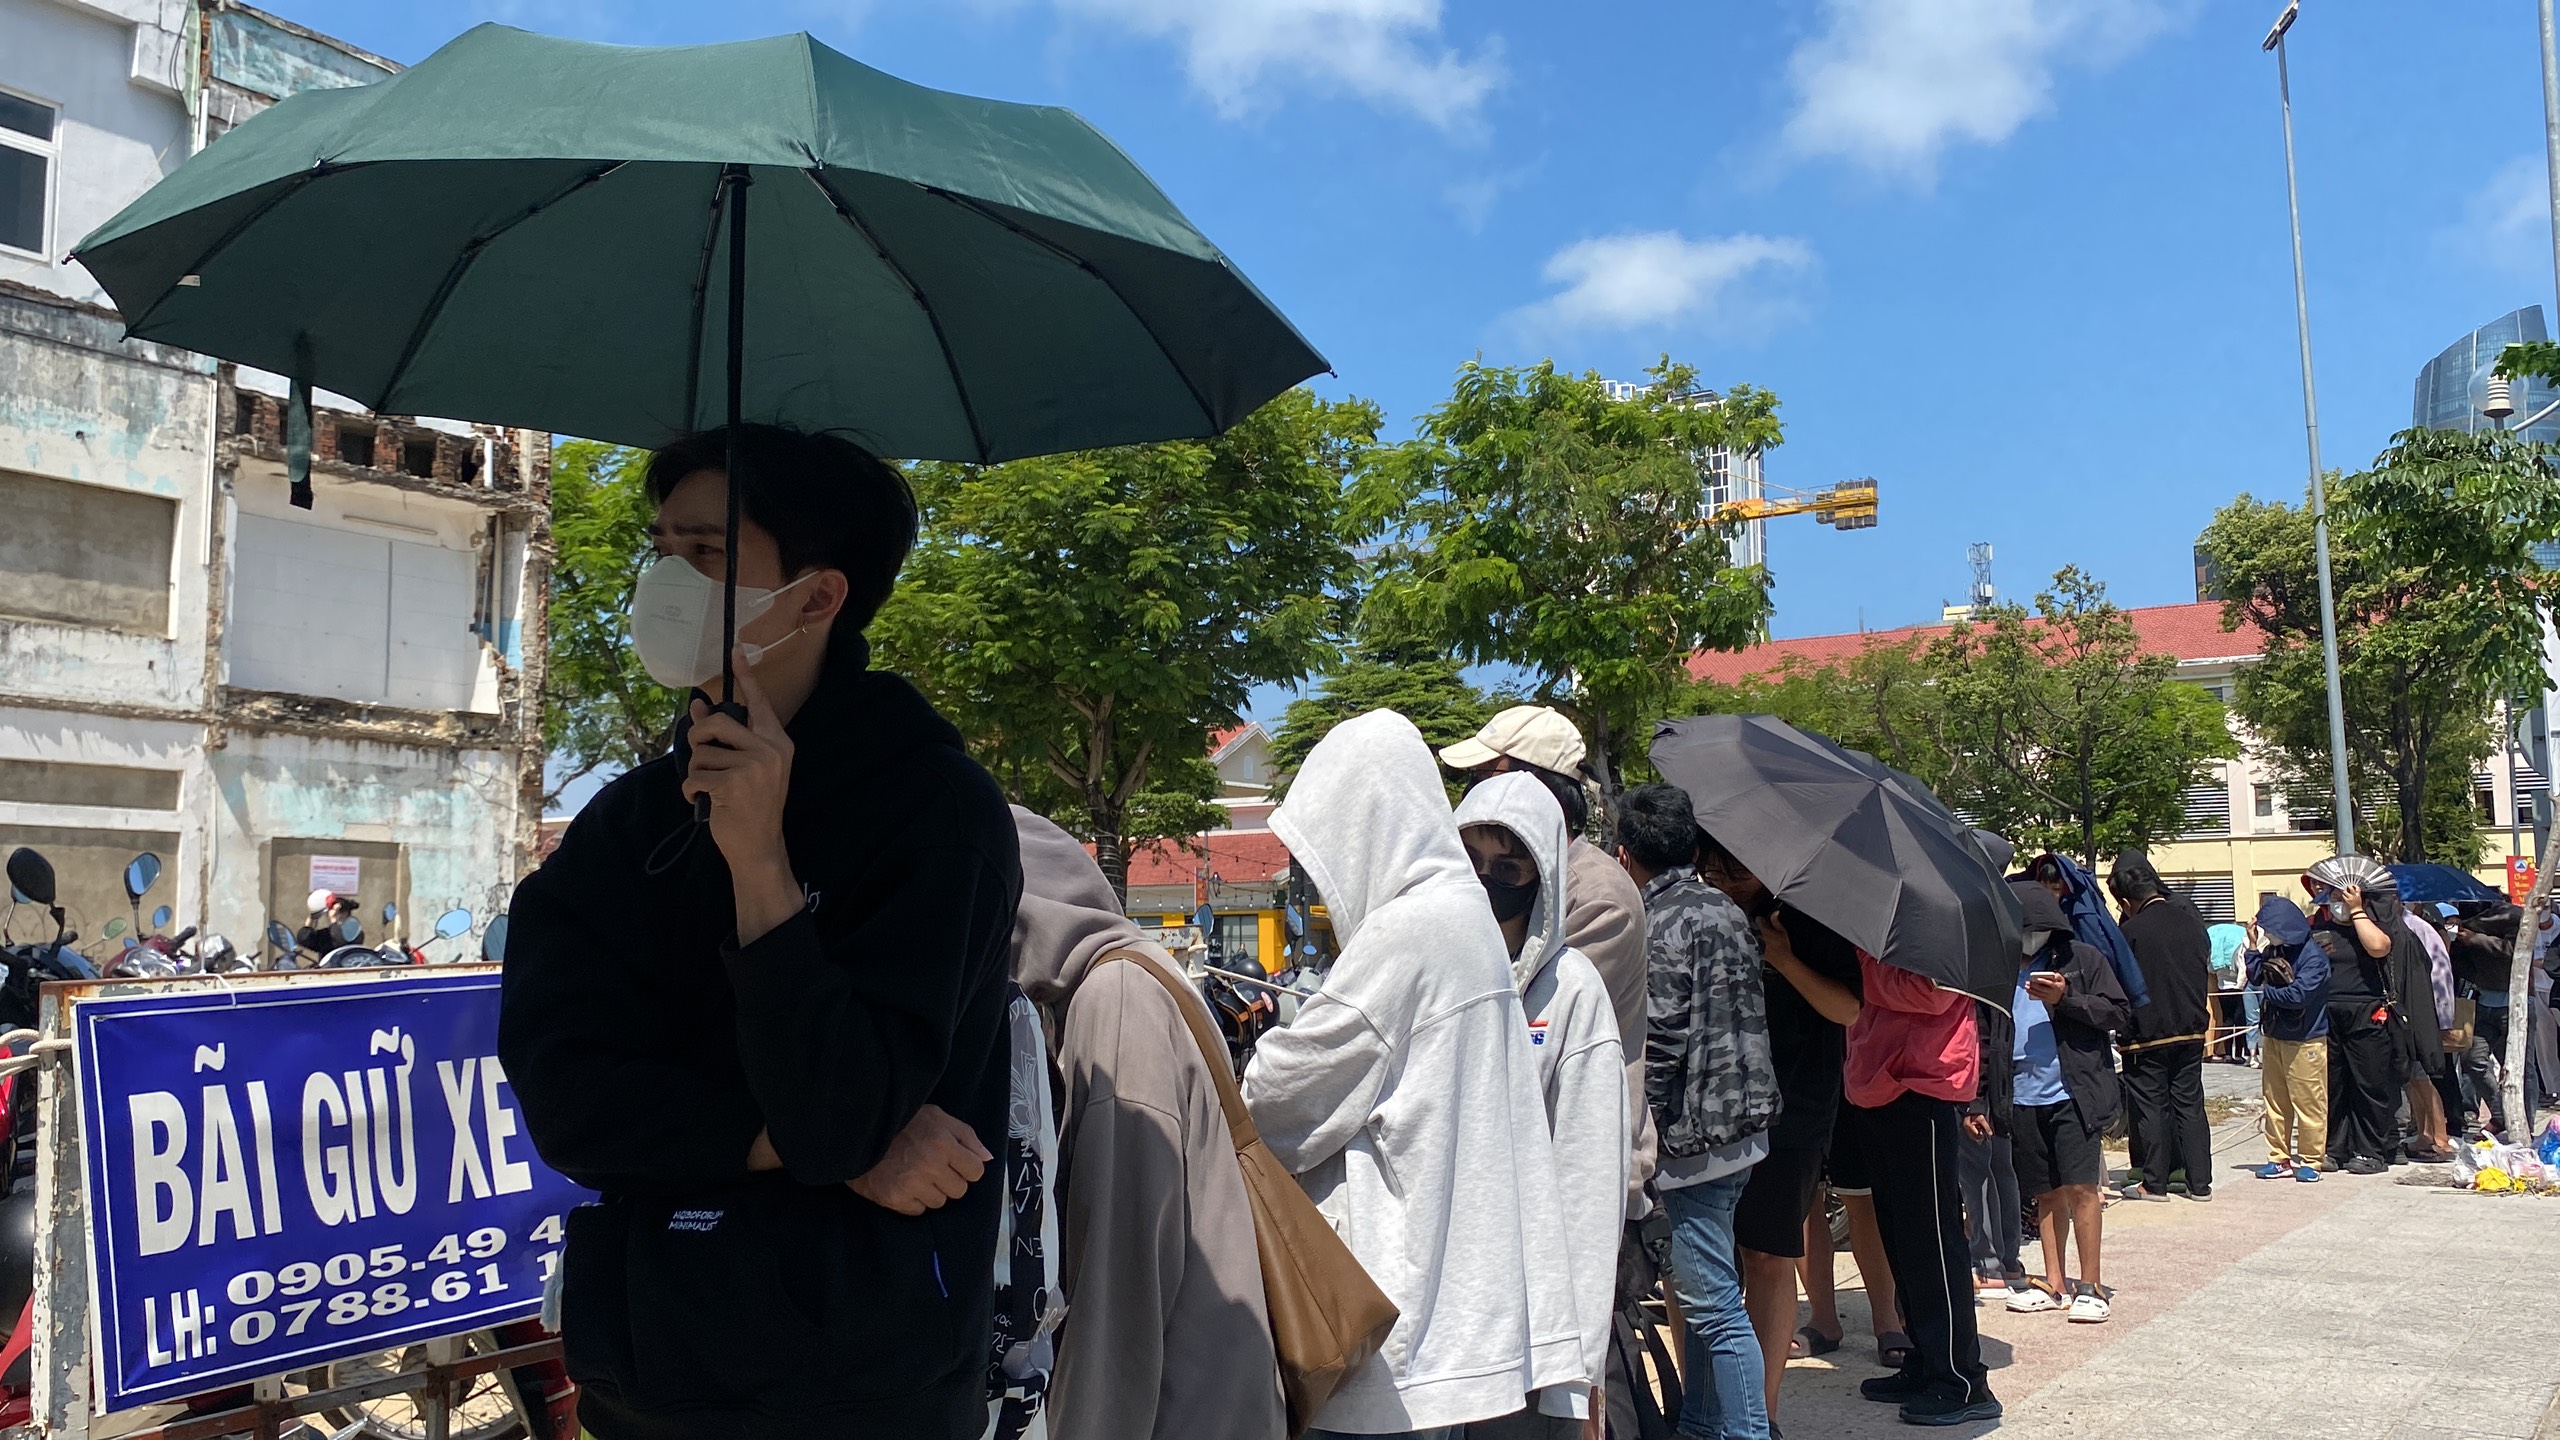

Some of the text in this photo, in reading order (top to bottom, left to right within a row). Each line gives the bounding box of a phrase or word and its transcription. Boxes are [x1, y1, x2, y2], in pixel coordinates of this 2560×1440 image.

[129, 1026, 532, 1256] BÃI GIỮ XE
[227, 1227, 507, 1304] 0905.49
[229, 1263, 509, 1345] 0788.61
[145, 1289, 217, 1367] LH:
